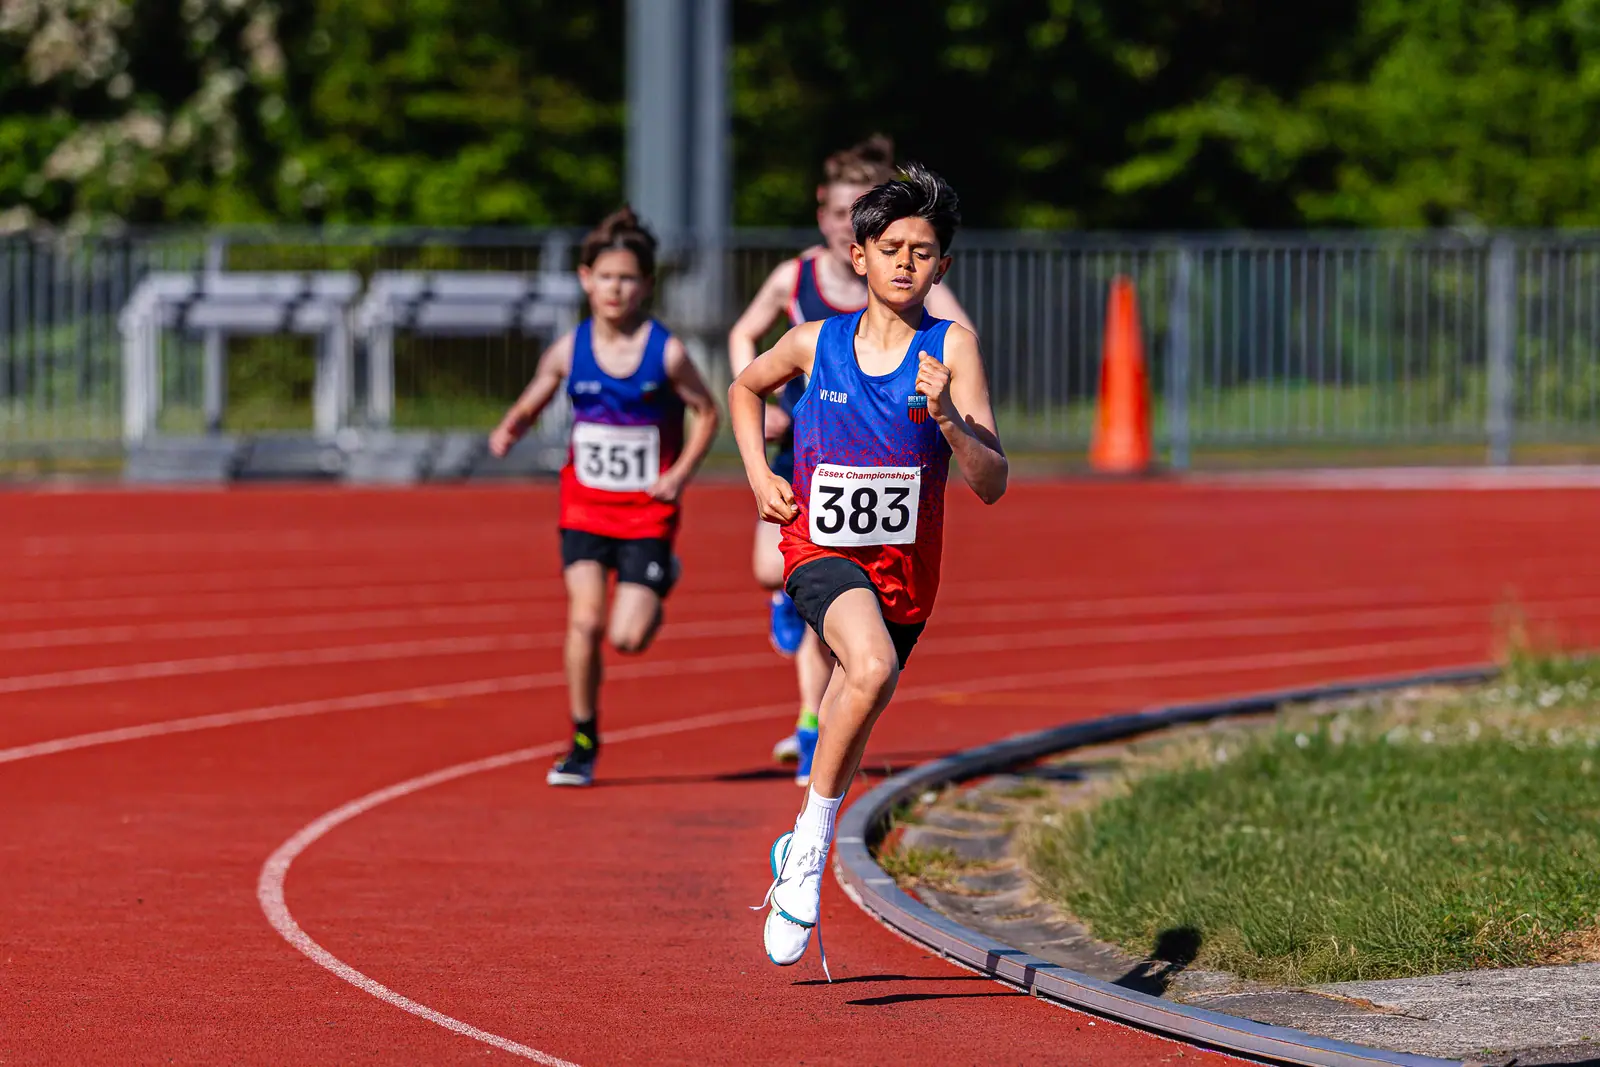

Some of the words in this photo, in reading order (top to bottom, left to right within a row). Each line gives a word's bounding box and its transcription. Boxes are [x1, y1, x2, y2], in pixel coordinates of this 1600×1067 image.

[584, 443, 647, 479] 351
[818, 468, 844, 478] Essex
[845, 471, 916, 480] Championships
[816, 485, 910, 534] 383
